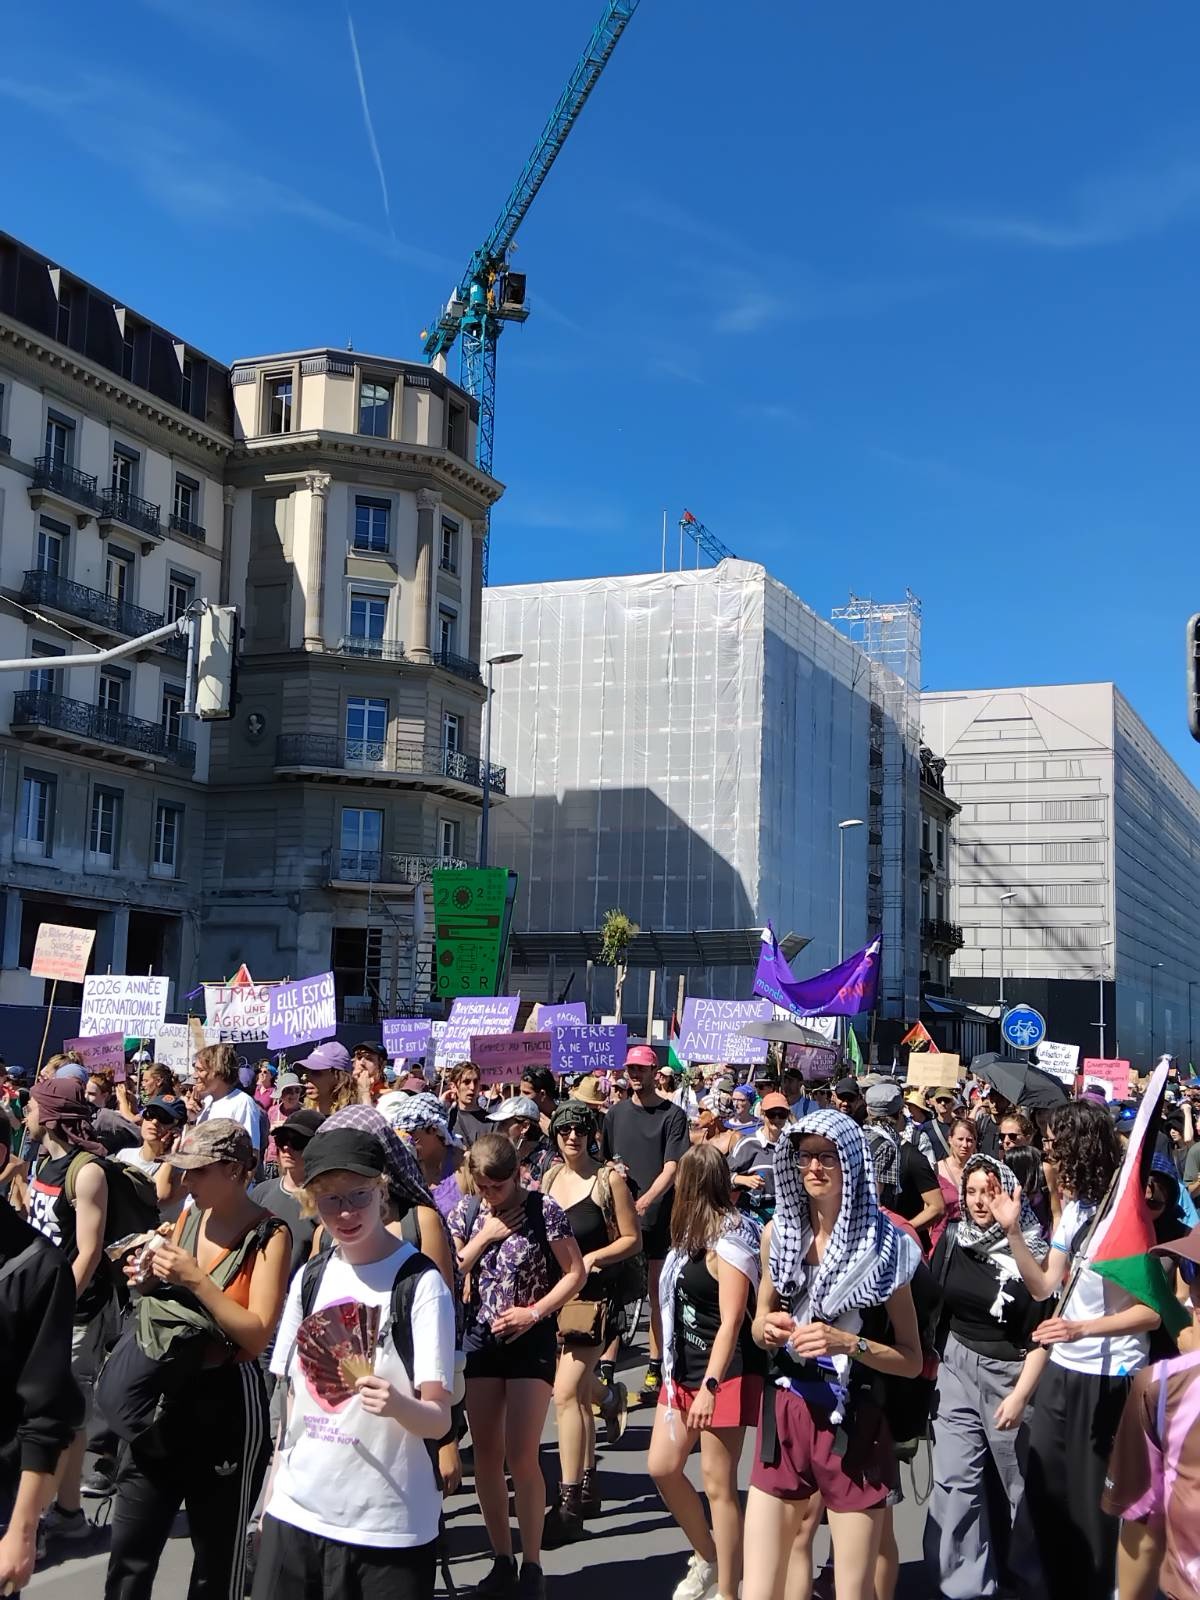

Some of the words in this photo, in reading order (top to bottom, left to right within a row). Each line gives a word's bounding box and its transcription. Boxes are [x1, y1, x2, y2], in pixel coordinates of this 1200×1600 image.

[87, 980, 121, 995] 2026
[125, 978, 162, 995] ANNÉE
[277, 988, 299, 1010] ELLE
[302, 983, 320, 1005] EST
[84, 998, 162, 1016] INTERNATIONALE
[244, 1005, 267, 1013] UNE
[694, 1000, 765, 1020] PAYSANNE
[272, 1012, 284, 1026] LA
[697, 1017, 755, 1032] FÉMINIST
[158, 1024, 188, 1037] GARDEZ
[386, 1037, 406, 1054] ELLE
[406, 1041, 417, 1052] EST
[558, 1041, 566, 1053] À
[570, 1043, 581, 1053] NE
[589, 1041, 611, 1053] PLUS
[683, 1031, 722, 1050] ANTI
[559, 1056, 573, 1069] SE
